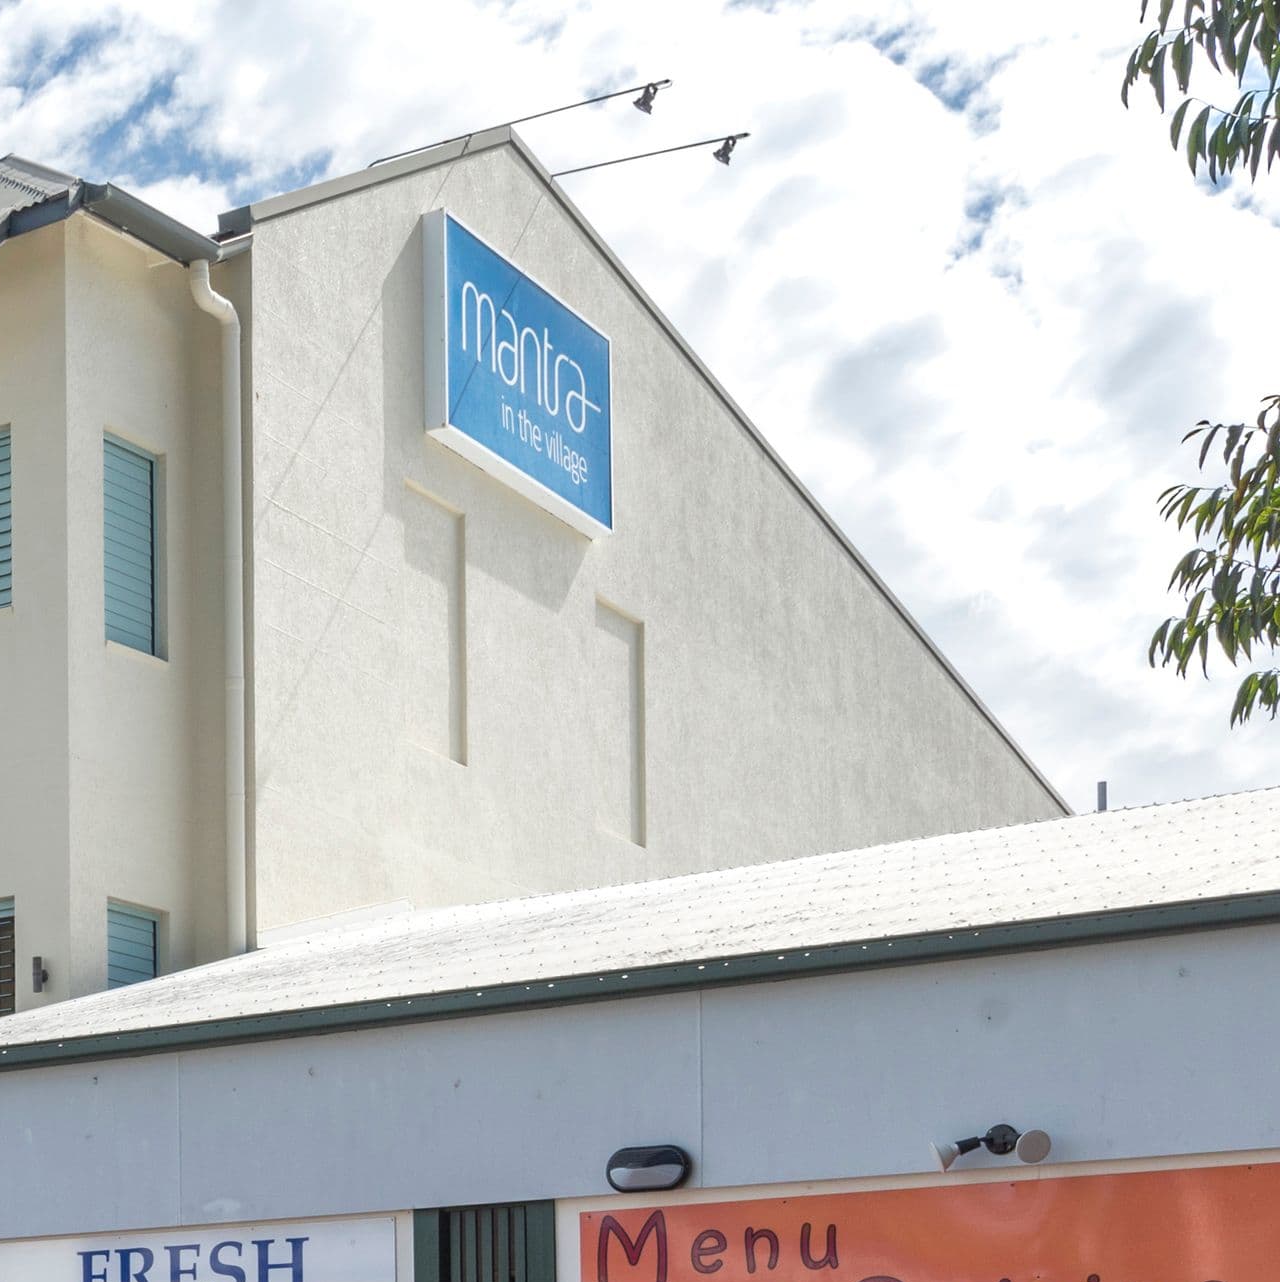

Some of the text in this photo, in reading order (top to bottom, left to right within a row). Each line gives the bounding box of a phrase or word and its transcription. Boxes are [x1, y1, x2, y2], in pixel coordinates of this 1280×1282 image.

[461, 281, 601, 433] mantra
[501, 396, 588, 484] in the village
